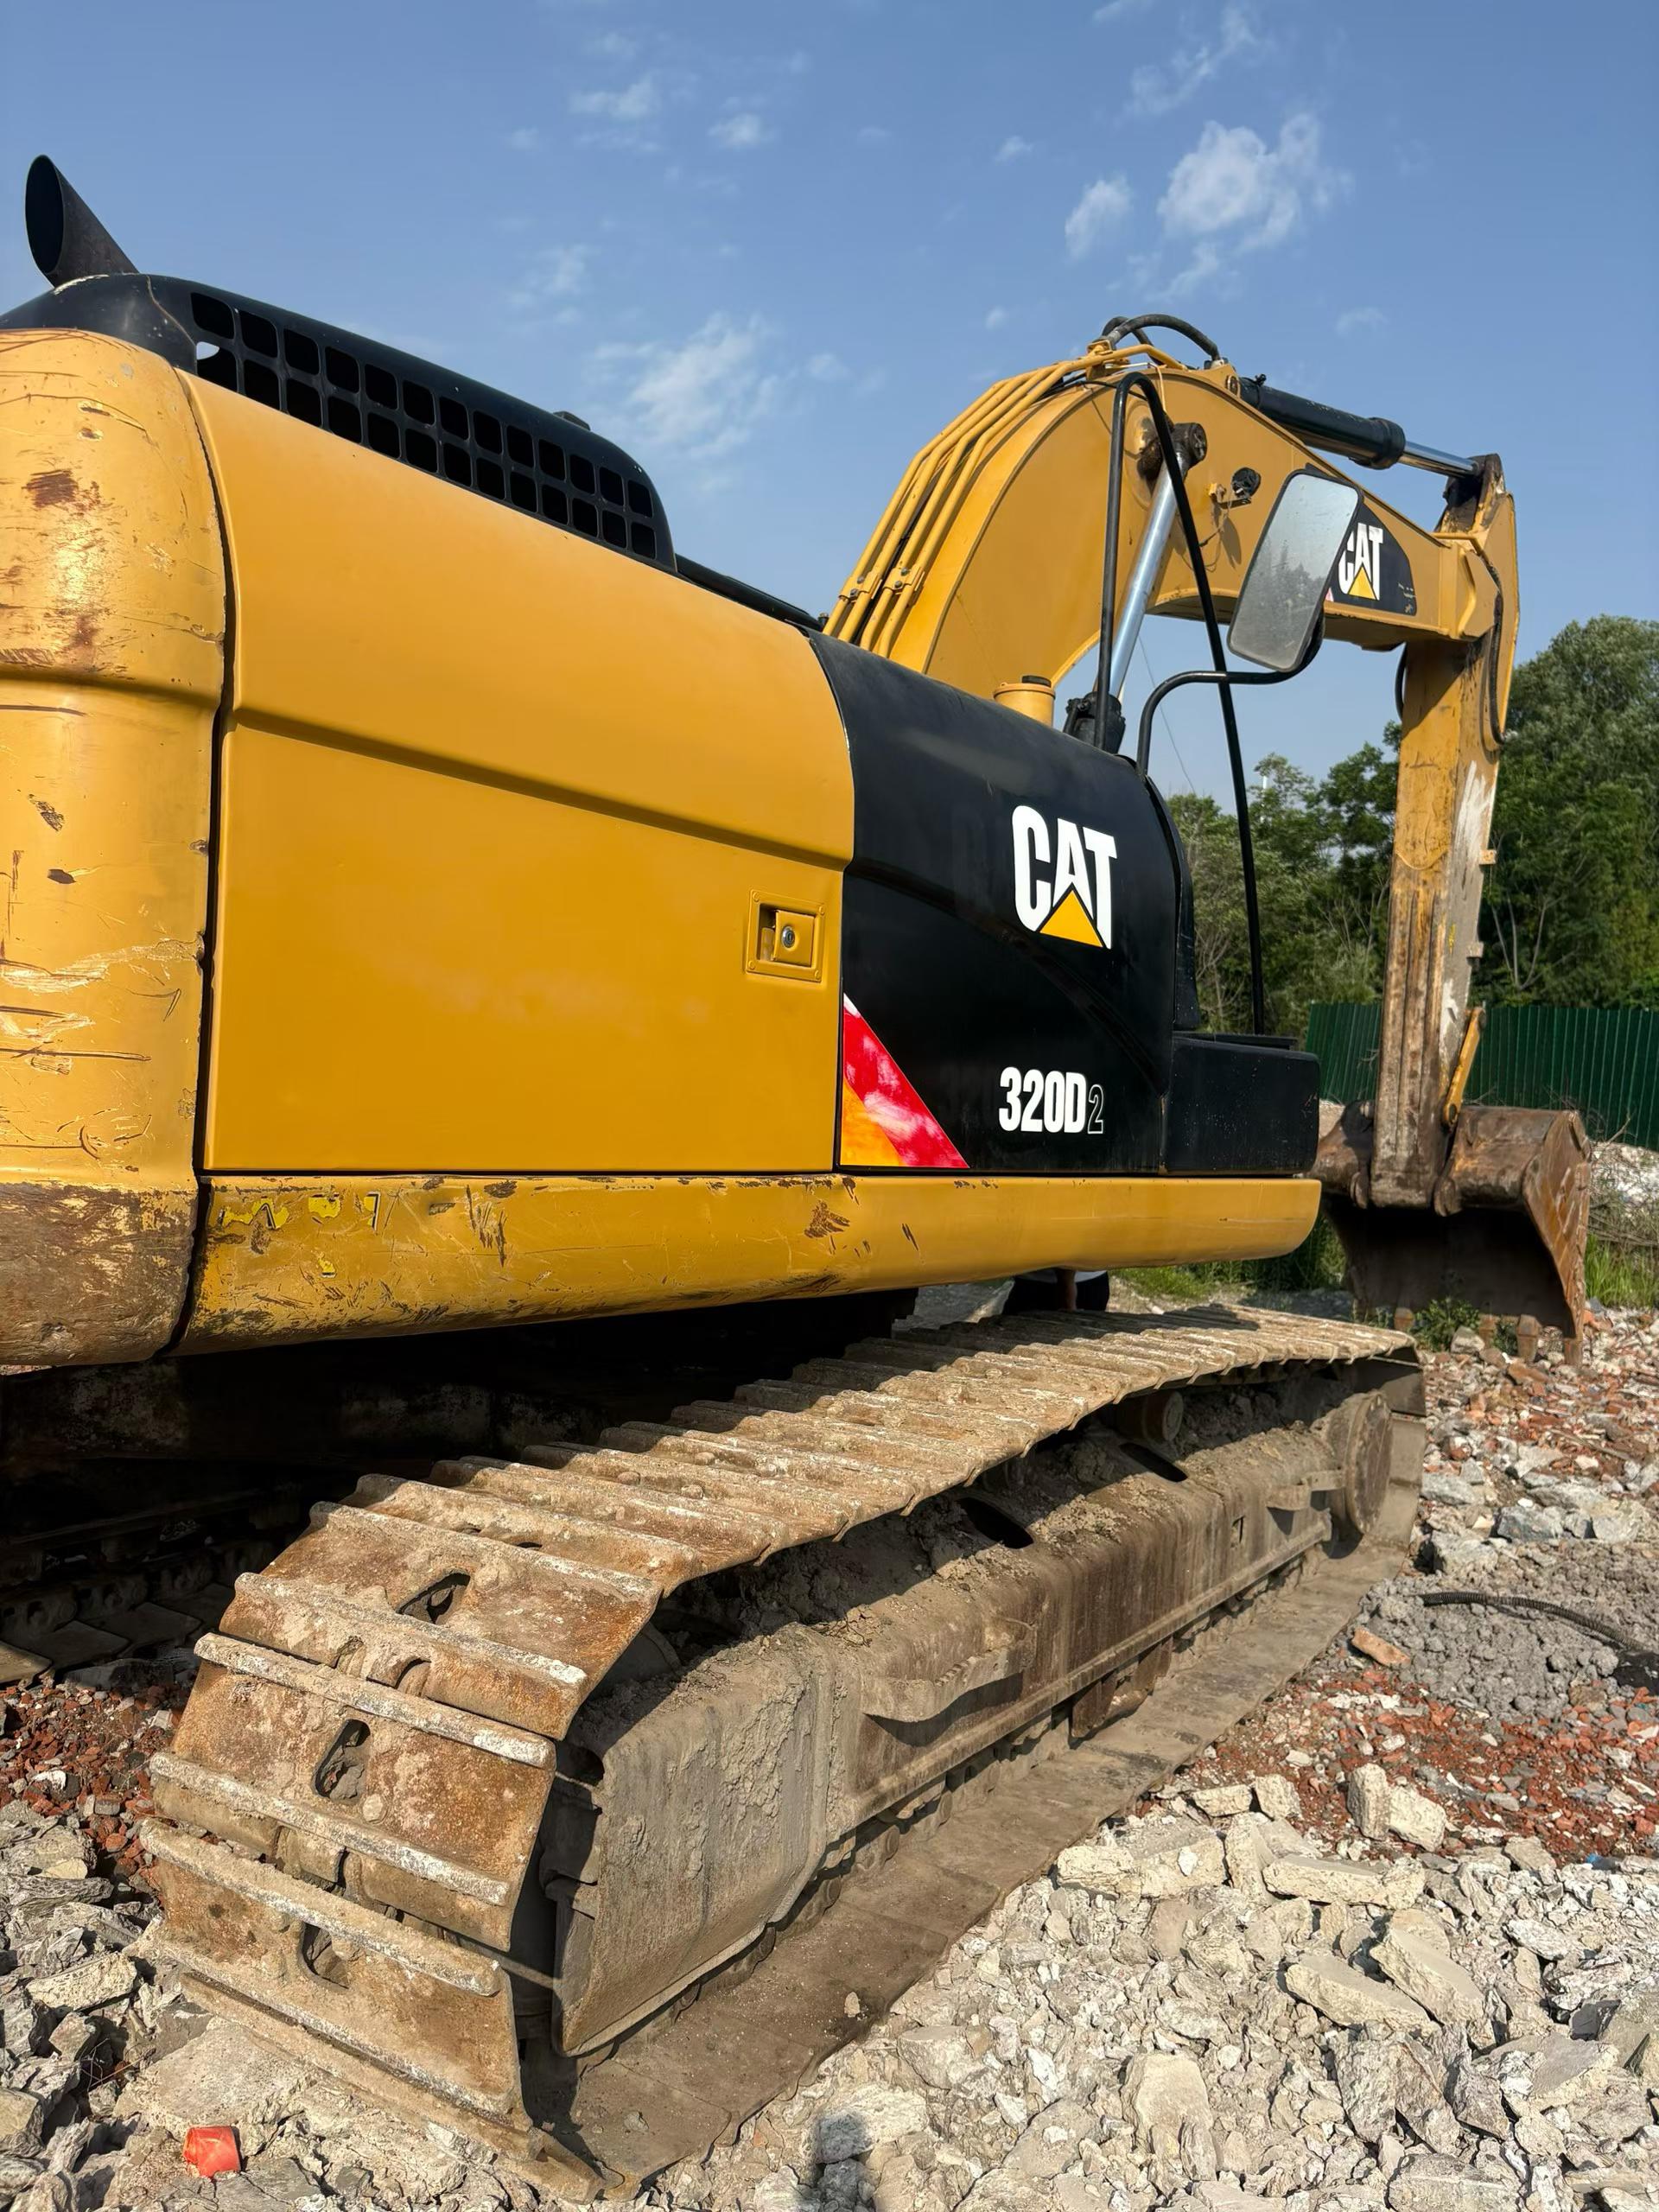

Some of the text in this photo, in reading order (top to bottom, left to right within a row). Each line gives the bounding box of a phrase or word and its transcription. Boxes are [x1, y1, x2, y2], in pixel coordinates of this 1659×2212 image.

[1338, 522, 1382, 601] CAT
[1012, 805, 1117, 949] CAT
[999, 1066, 1103, 1134] 320D2
